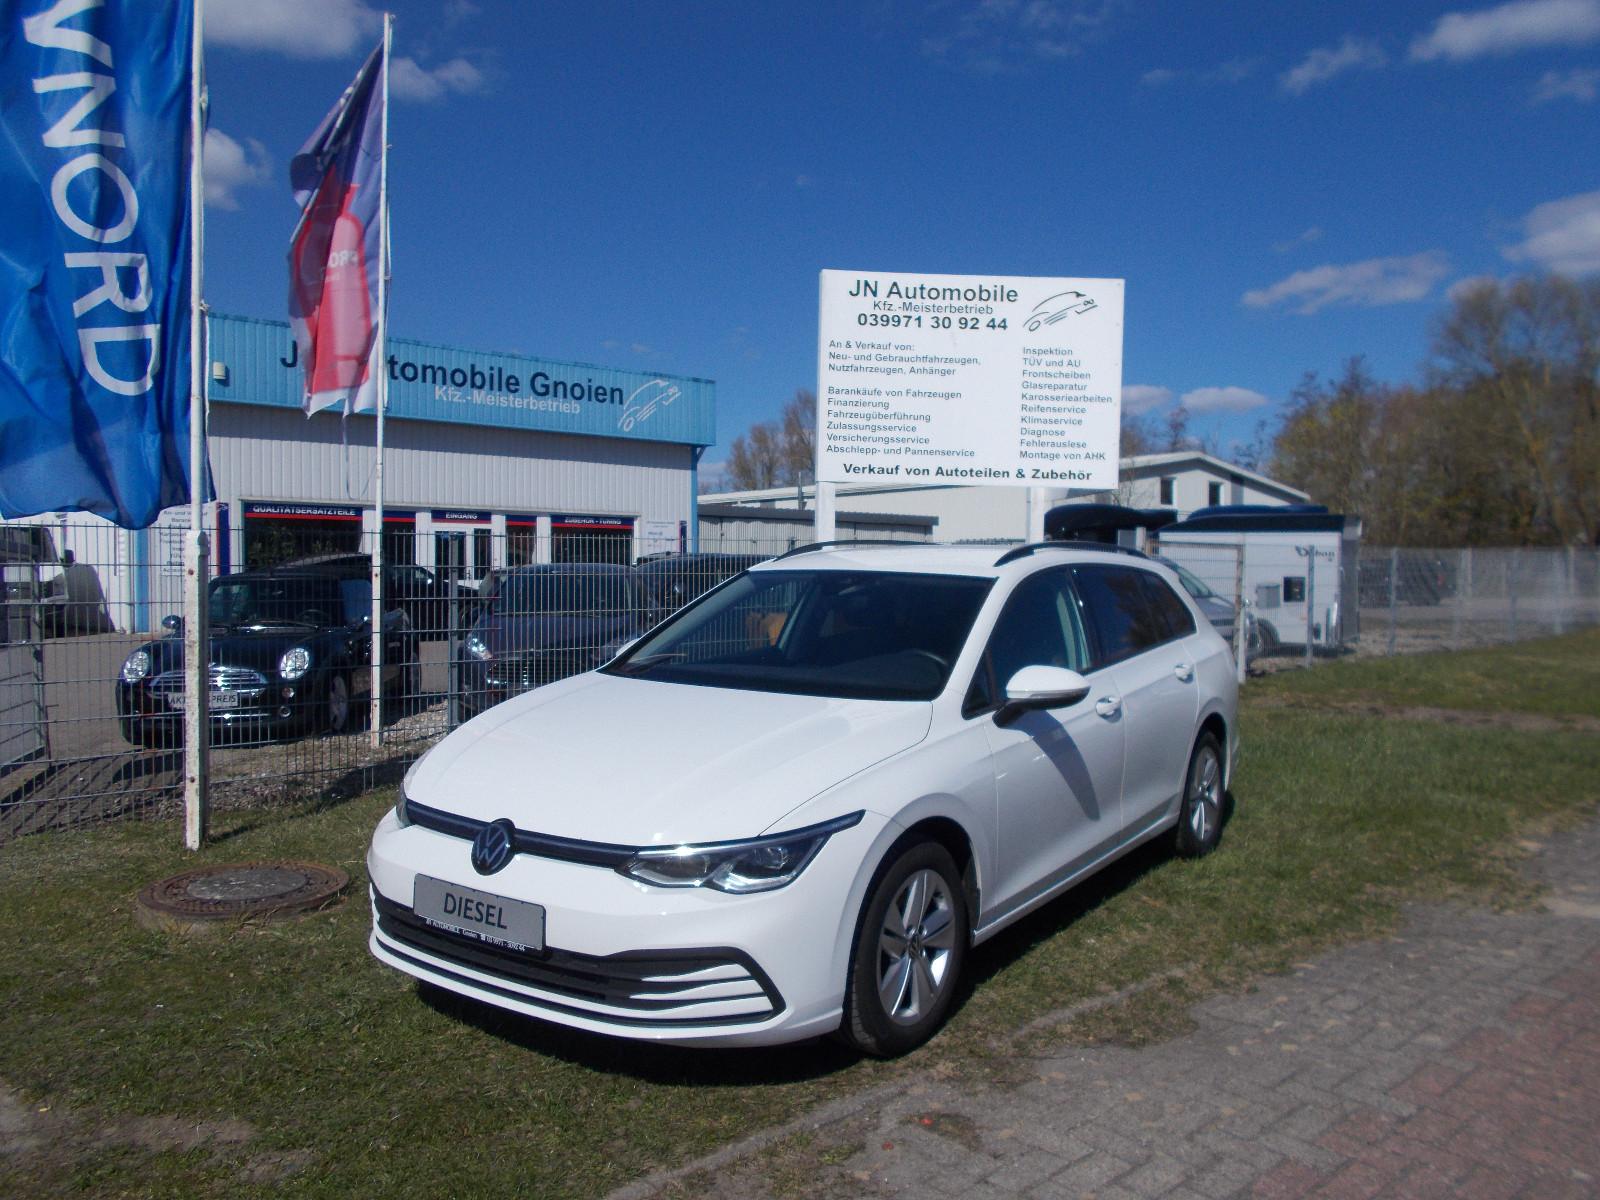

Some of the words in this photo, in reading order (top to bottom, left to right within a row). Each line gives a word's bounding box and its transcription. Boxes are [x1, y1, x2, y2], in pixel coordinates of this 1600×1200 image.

[849, 279, 878, 298] JN
[887, 281, 1018, 303] Automobile
[873, 300, 994, 315] Kfz.-Meisterbetrieb
[857, 313, 922, 329] 039971
[931, 315, 952, 329] 30
[958, 317, 980, 330] 92
[986, 318, 1008, 331] 44
[828, 339, 842, 349] An
[845, 340, 853, 349] &
[855, 340, 892, 351] Verkauf
[894, 343, 915, 352] von:
[1022, 346, 1073, 357] Inspektion
[828, 351, 851, 361] Neu-
[853, 353, 872, 362] und
[1022, 356, 1043, 367] TÜV
[1045, 358, 1064, 367] und
[1066, 359, 1082, 368] AU
[908, 365, 956, 377] Anhänger
[1022, 369, 1091, 380] Frontscheiben
[387, 353, 520, 394] tomobile
[530, 371, 624, 406] Gnoien
[1021, 380, 1088, 391] Glasreparatur
[434, 384, 581, 414] Kfz.-Meisterbetrieb
[827, 385, 883, 397] Barankäufe
[885, 389, 903, 398] von
[905, 388, 962, 401] Fahrzeugen
[1021, 392, 1113, 403] Karosseriearbeiten
[827, 397, 890, 410] Finanzierung
[1020, 403, 1087, 414] Reifenservice
[827, 409, 931, 423] Fahrzeugüberführung
[1020, 415, 1083, 426] Klimaservice
[826, 421, 917, 433] Zulassungsservice
[1020, 427, 1066, 438] Diagnose
[826, 433, 930, 445] Versicherungsservice
[1019, 438, 1087, 449] Fehlerauslese
[826, 444, 881, 456] Abschlepp-
[883, 446, 902, 455] und
[904, 448, 975, 458] Pannenservice
[1019, 450, 1060, 461] Montage
[1063, 452, 1081, 461] von
[1084, 452, 1107, 461] AHK
[843, 463, 900, 476] Verkauf
[905, 467, 930, 477] von
[935, 466, 1010, 480] Autoteilen
[1015, 468, 1026, 480] &
[1031, 468, 1093, 481] Zubehör
[445, 511, 478, 520] EINGANG
[443, 892, 508, 930] DIESEL
